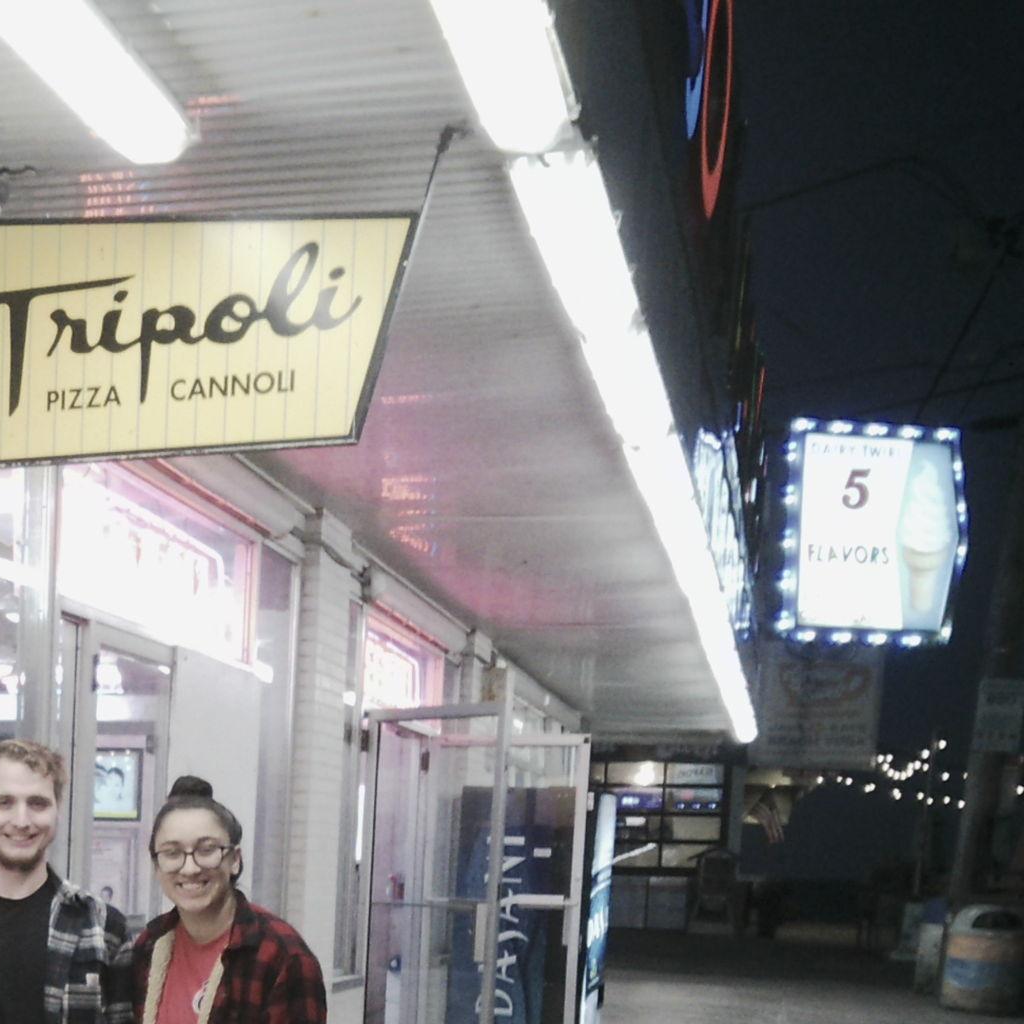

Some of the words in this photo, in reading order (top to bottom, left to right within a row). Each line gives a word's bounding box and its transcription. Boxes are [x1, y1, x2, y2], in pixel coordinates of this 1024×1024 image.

[47, 384, 122, 412] PIZZA
[170, 369, 295, 402] CANNOLI
[842, 468, 871, 510] 5
[808, 543, 890, 565] FLAVORS
